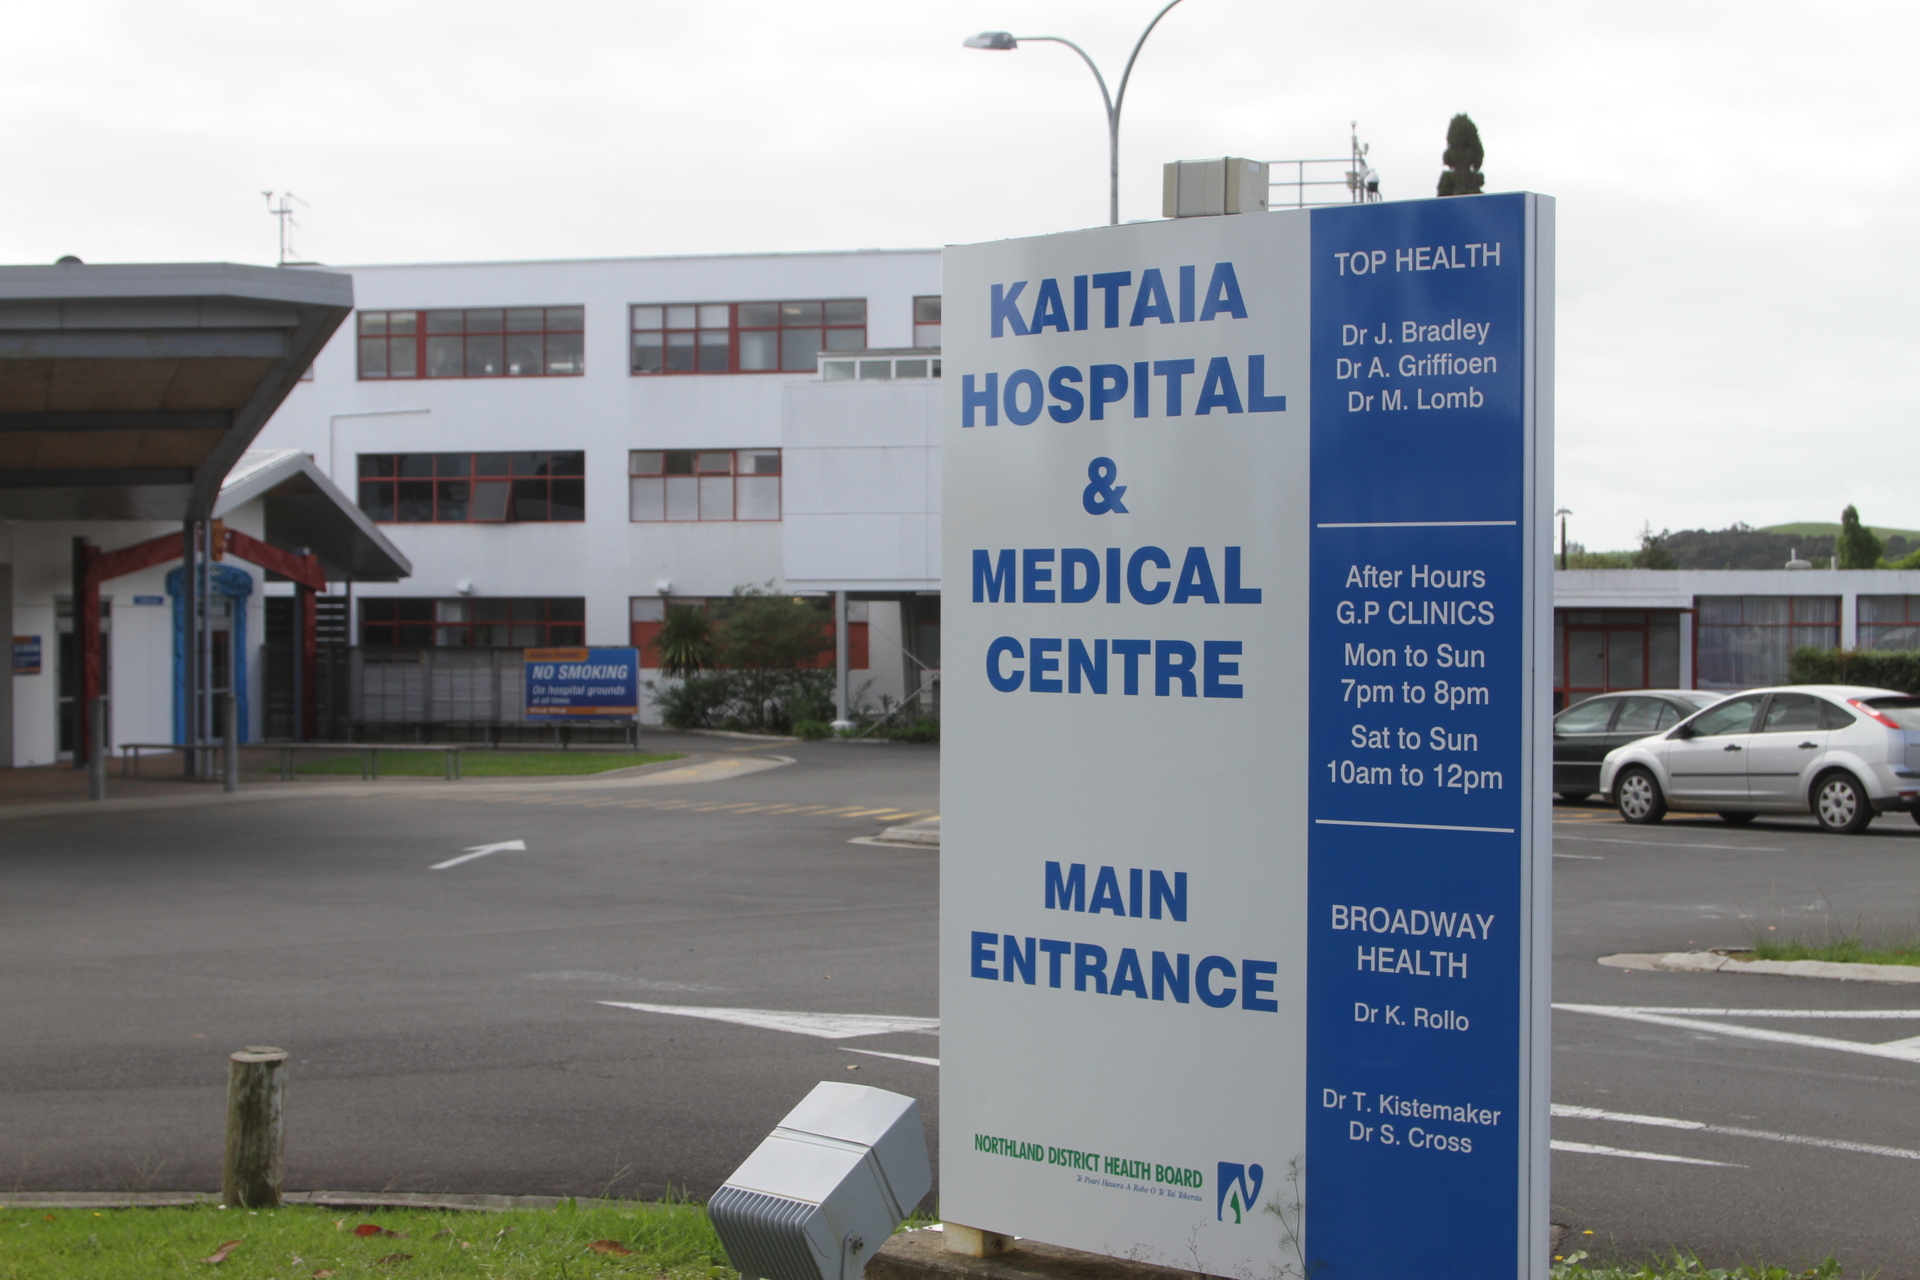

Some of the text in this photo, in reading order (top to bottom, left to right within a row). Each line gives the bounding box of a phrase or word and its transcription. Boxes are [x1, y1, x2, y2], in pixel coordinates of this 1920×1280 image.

[1334, 242, 1501, 276] TOP HEALTH
[990, 262, 1249, 338] KAITAIA
[1342, 318, 1491, 346] Dr J. Bradley
[1336, 352, 1497, 380] Dr A. Griffioen
[961, 354, 1287, 428] HOSPITAL
[1348, 386, 1484, 412] Dr M. Lomb
[1082, 456, 1130, 516] &
[972, 545, 1263, 605] MEDICAL
[1345, 564, 1486, 589] After Hours
[1336, 600, 1495, 626] G.P CLINICS
[985, 635, 1244, 699] CENTRE
[1344, 642, 1485, 668] Mon to Sun
[532, 664, 628, 680] NO SMOKING
[532, 684, 626, 697] On hospital grounds
[1341, 678, 1489, 711] 7pm to 8pm
[1350, 724, 1478, 752] Sat to Sun
[1327, 759, 1503, 795] 10am to 12pm
[1044, 860, 1188, 922] MAIN
[1331, 904, 1495, 940] BROADWAY
[970, 930, 1279, 1013] ENTRANCE
[1357, 945, 1467, 979] HEALTH
[1354, 1002, 1470, 1032] Dr K. Rollo
[1322, 1088, 1501, 1126] Dr T. Kistemaker
[1349, 1120, 1472, 1153] Dr S. Cross
[974, 1133, 1203, 1189] NORTHLAND DISTRICT HEALTH BOARD
[1076, 1174, 1203, 1202] Te Poari Hauora A Rohe O Te Tai Tokerau
